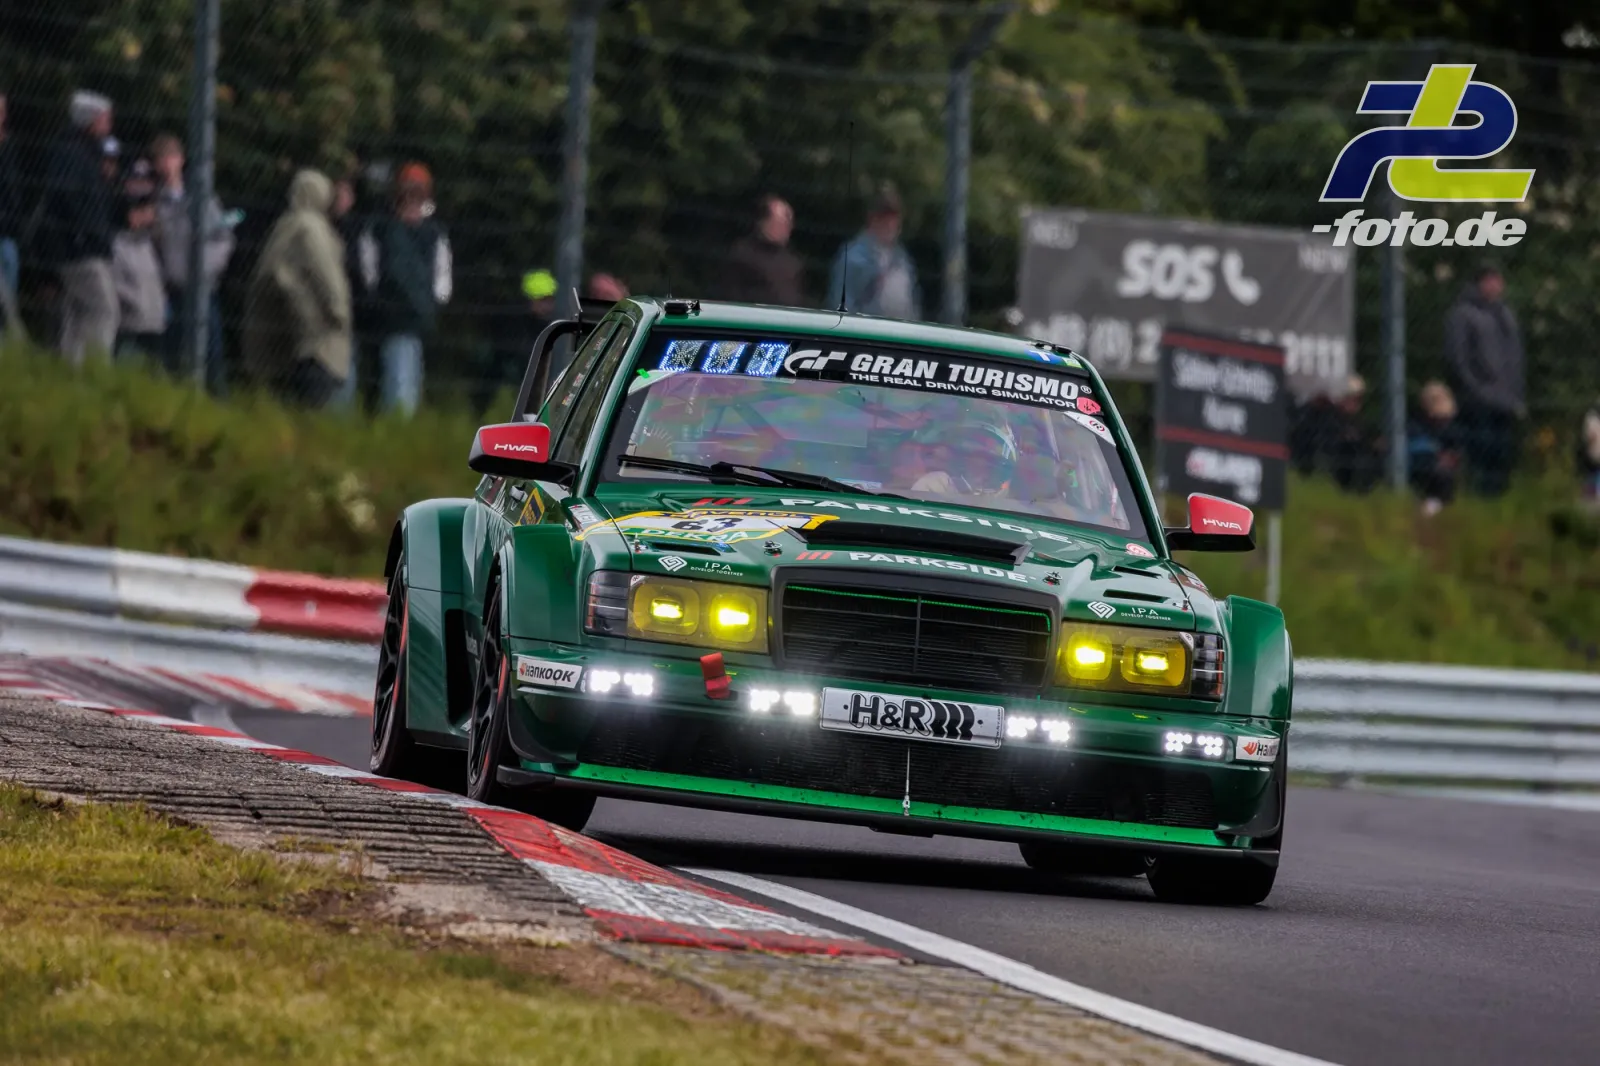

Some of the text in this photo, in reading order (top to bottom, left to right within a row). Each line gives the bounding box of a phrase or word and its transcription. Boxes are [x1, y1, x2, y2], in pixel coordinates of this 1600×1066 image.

[1117, 239, 1219, 299] SOS
[850, 353, 939, 379] GRAN
[849, 372, 1076, 410] THE REAL DRIVING SIMULATOR
[493, 443, 539, 454] HWA
[780, 498, 1072, 544] PARKSIDE
[1202, 517, 1243, 531] HWA
[641, 528, 750, 544] DEKRA
[705, 561, 732, 571] IPA
[716, 569, 744, 577] TOGETHER
[849, 551, 1029, 584] PARKSIDE
[1131, 607, 1159, 616] IPA
